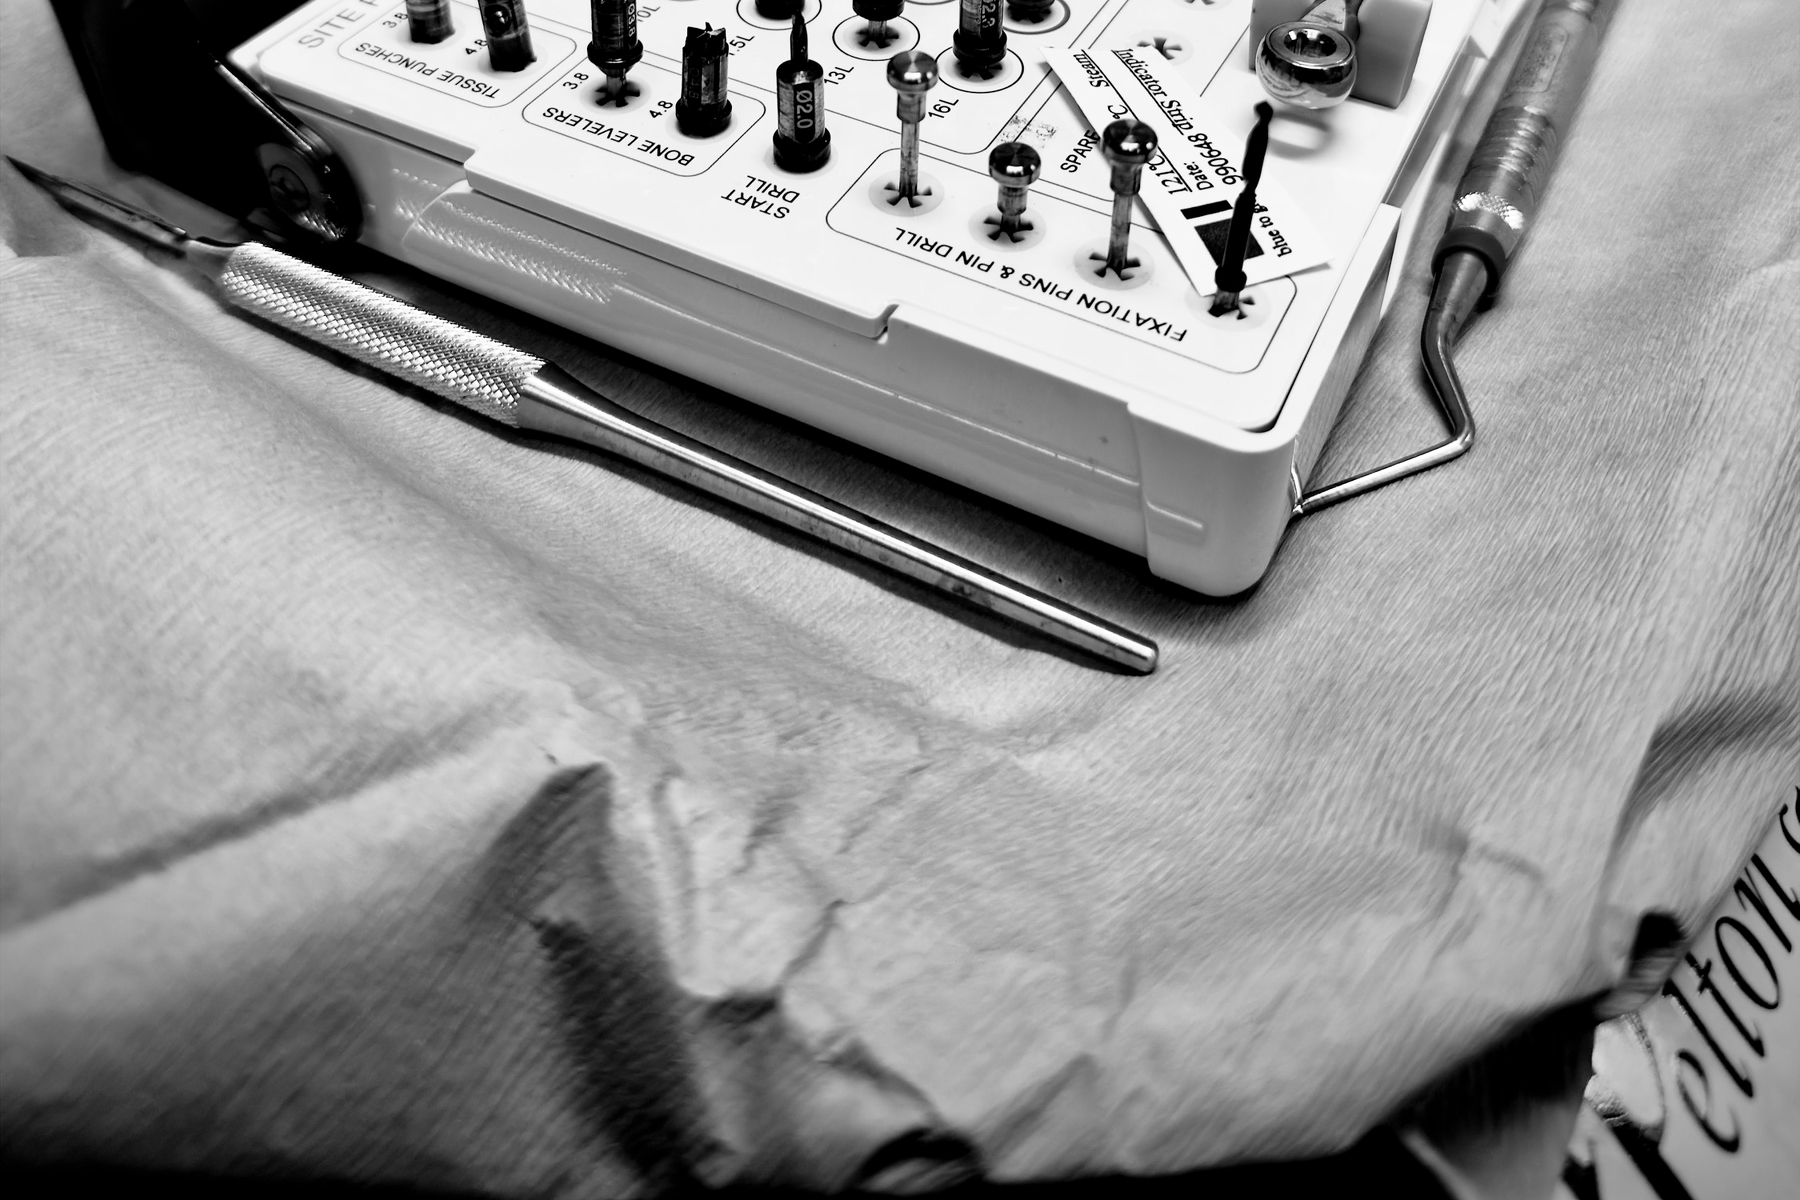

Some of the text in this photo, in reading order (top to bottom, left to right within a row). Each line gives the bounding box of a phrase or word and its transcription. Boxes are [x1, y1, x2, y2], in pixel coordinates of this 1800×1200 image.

[298, 8, 366, 48] SITE
[383, 12, 409, 29] 3.8
[464, 38, 489, 56] 4.8
[355, 42, 501, 99] TISSUE PUNCHES
[562, 72, 589, 91] 3.8
[824, 65, 855, 85] 13L
[1073, 52, 1111, 88] Steam
[1113, 48, 1194, 131] Indicator Strip
[649, 100, 674, 119] 4.8
[928, 98, 960, 120] 16L
[543, 106, 695, 166] BONE LEVELERS
[1060, 129, 1101, 173] SPARE
[1187, 132, 1244, 186] 990648
[746, 175, 801, 204] DRILL
[1183, 161, 1214, 191] Date:
[721, 188, 791, 220] START
[1258, 216, 1274, 228] to
[1268, 229, 1293, 257] blue
[895, 227, 1188, 342] FIXATION PINS & PIN DRILL
